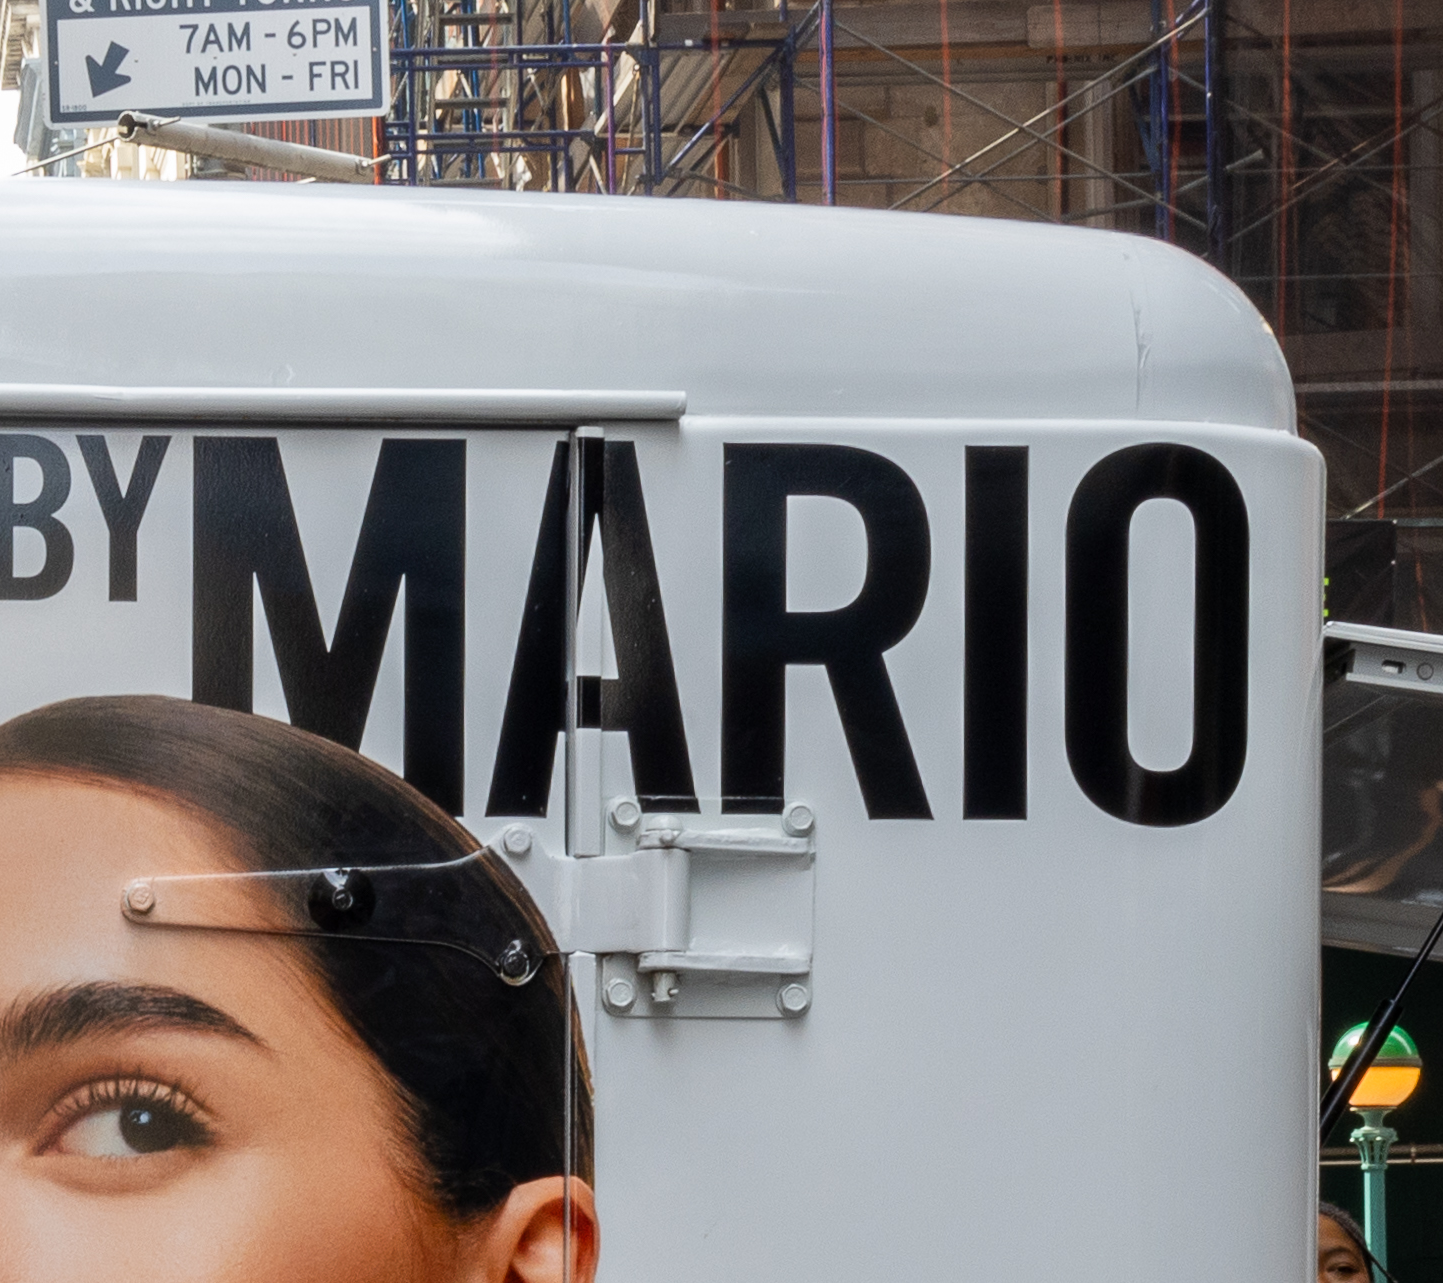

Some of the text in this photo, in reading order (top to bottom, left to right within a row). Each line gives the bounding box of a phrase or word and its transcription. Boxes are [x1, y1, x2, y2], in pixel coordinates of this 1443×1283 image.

[179, 22, 251, 54] 7AM
[287, 17, 359, 49] 6PM
[194, 63, 266, 96] MON
[309, 60, 360, 92] FRI
[193, 437, 1251, 827] MARIO
